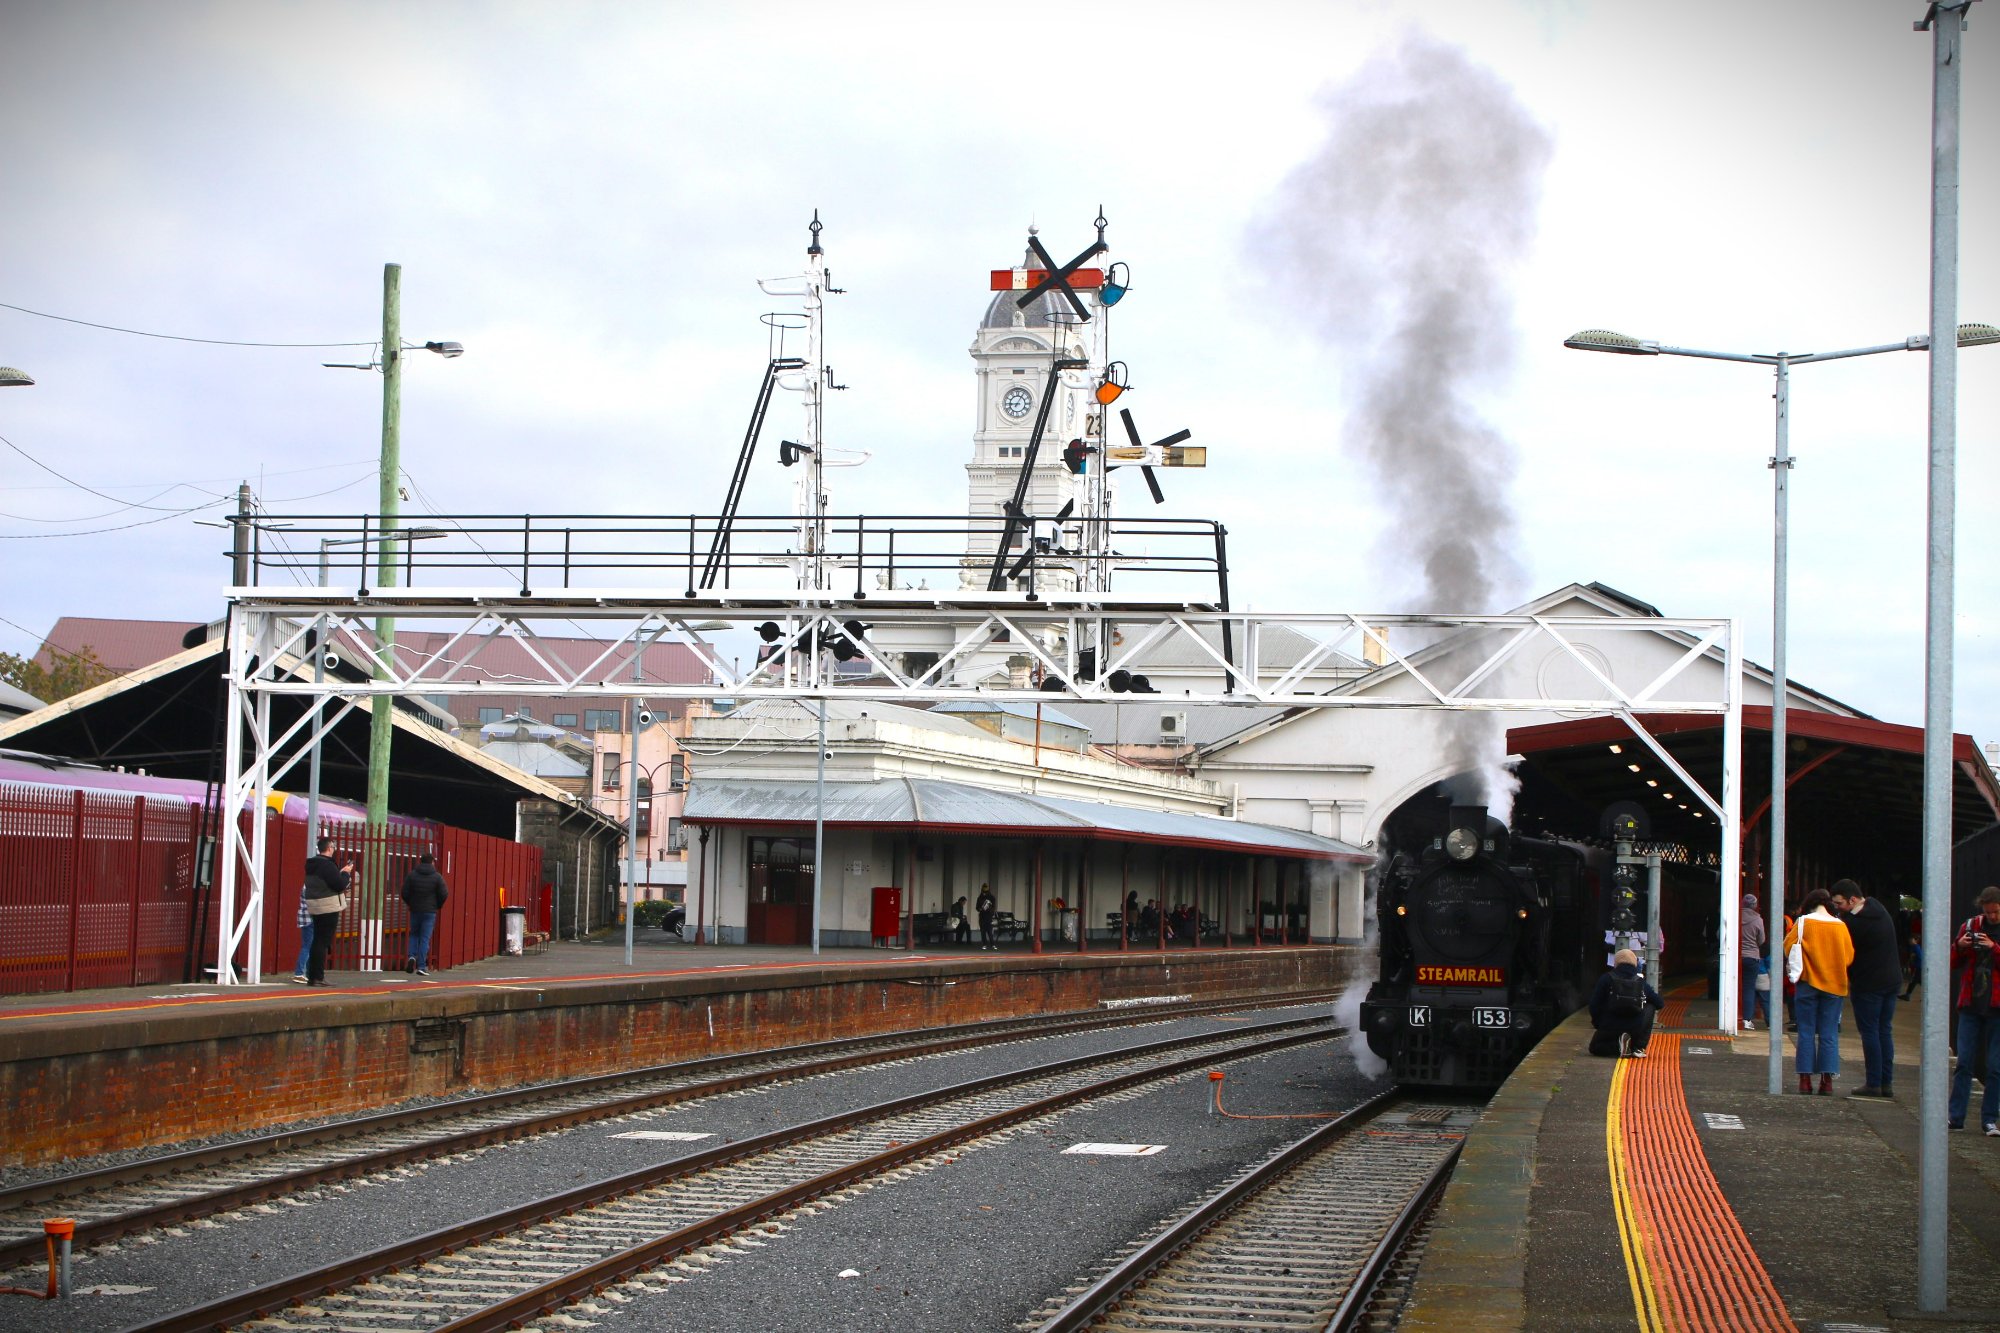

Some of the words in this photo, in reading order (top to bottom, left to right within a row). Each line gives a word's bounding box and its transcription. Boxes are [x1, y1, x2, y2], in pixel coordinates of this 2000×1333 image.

[1087, 415, 1102, 436] 23
[1418, 967, 1502, 982] STEAMRAIL
[1414, 1008, 1425, 1023] K
[1477, 1010, 1506, 1025] 153
